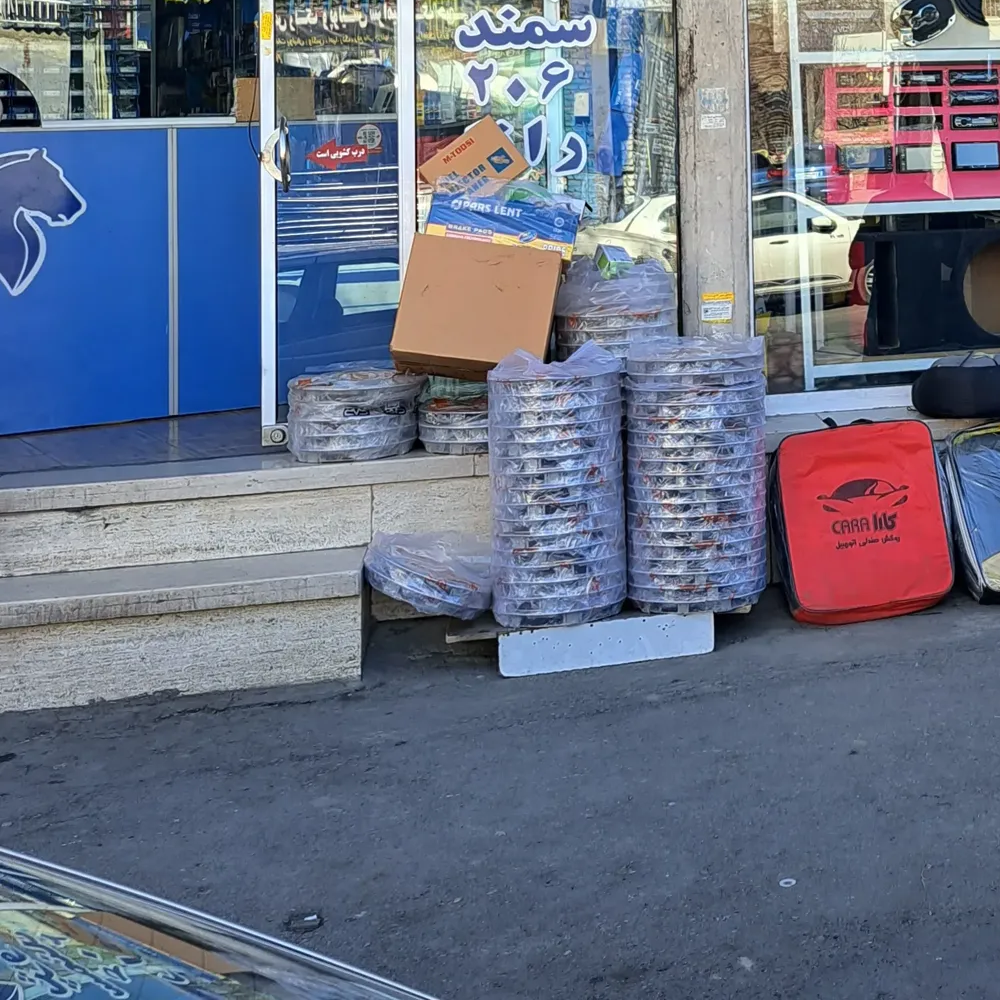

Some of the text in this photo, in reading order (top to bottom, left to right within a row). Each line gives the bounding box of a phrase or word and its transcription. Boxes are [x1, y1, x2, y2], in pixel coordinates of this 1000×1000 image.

[456, 5, 594, 50] سمند
[466, 58, 573, 107] ۲۰۶
[316, 147, 365, 159] درب کشویی است
[462, 200, 523, 218] PARS LENT
[832, 517, 870, 535] CARA
